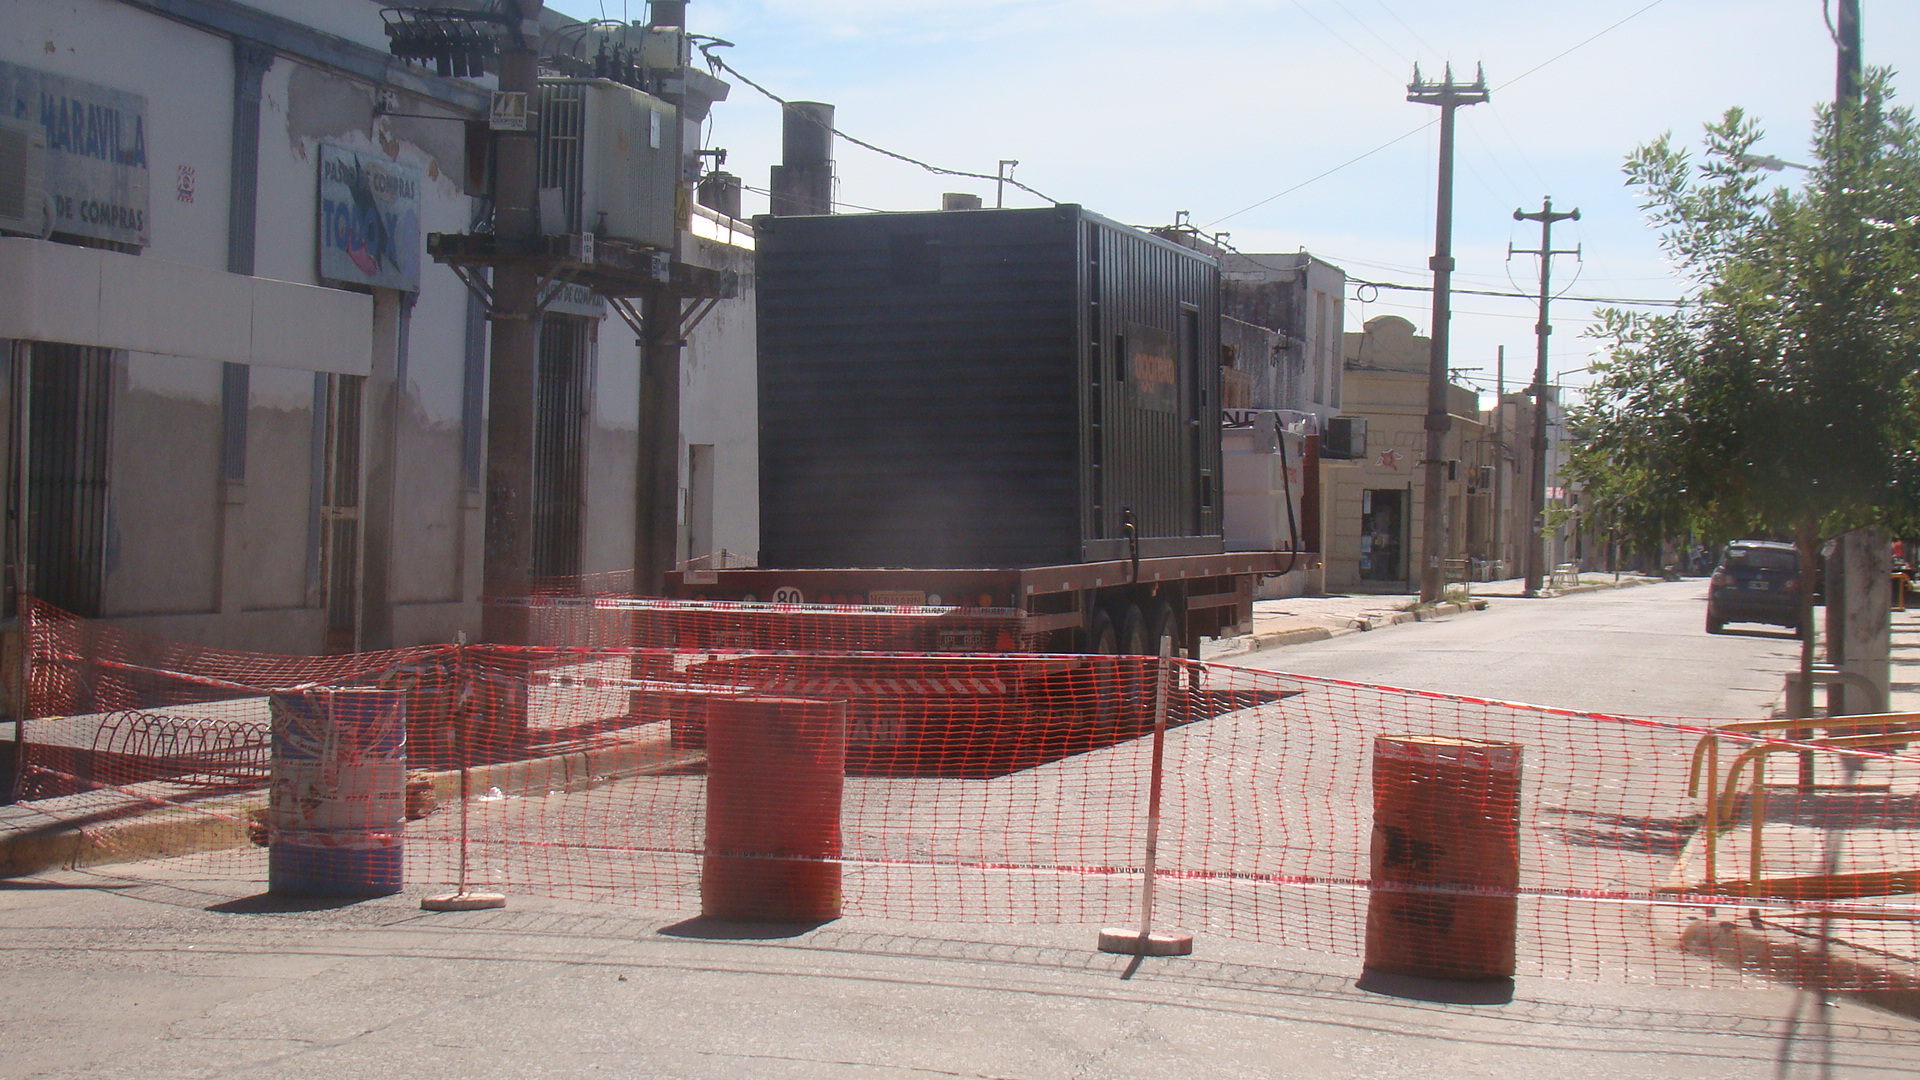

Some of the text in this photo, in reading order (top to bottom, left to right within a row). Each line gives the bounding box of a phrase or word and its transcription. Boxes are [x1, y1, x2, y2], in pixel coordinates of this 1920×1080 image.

[374, 171, 415, 199] COMPRAS
[56, 194, 143, 232] DE COMPRAS
[777, 586, 799, 601] 80
[870, 593, 921, 605] HERMANN
